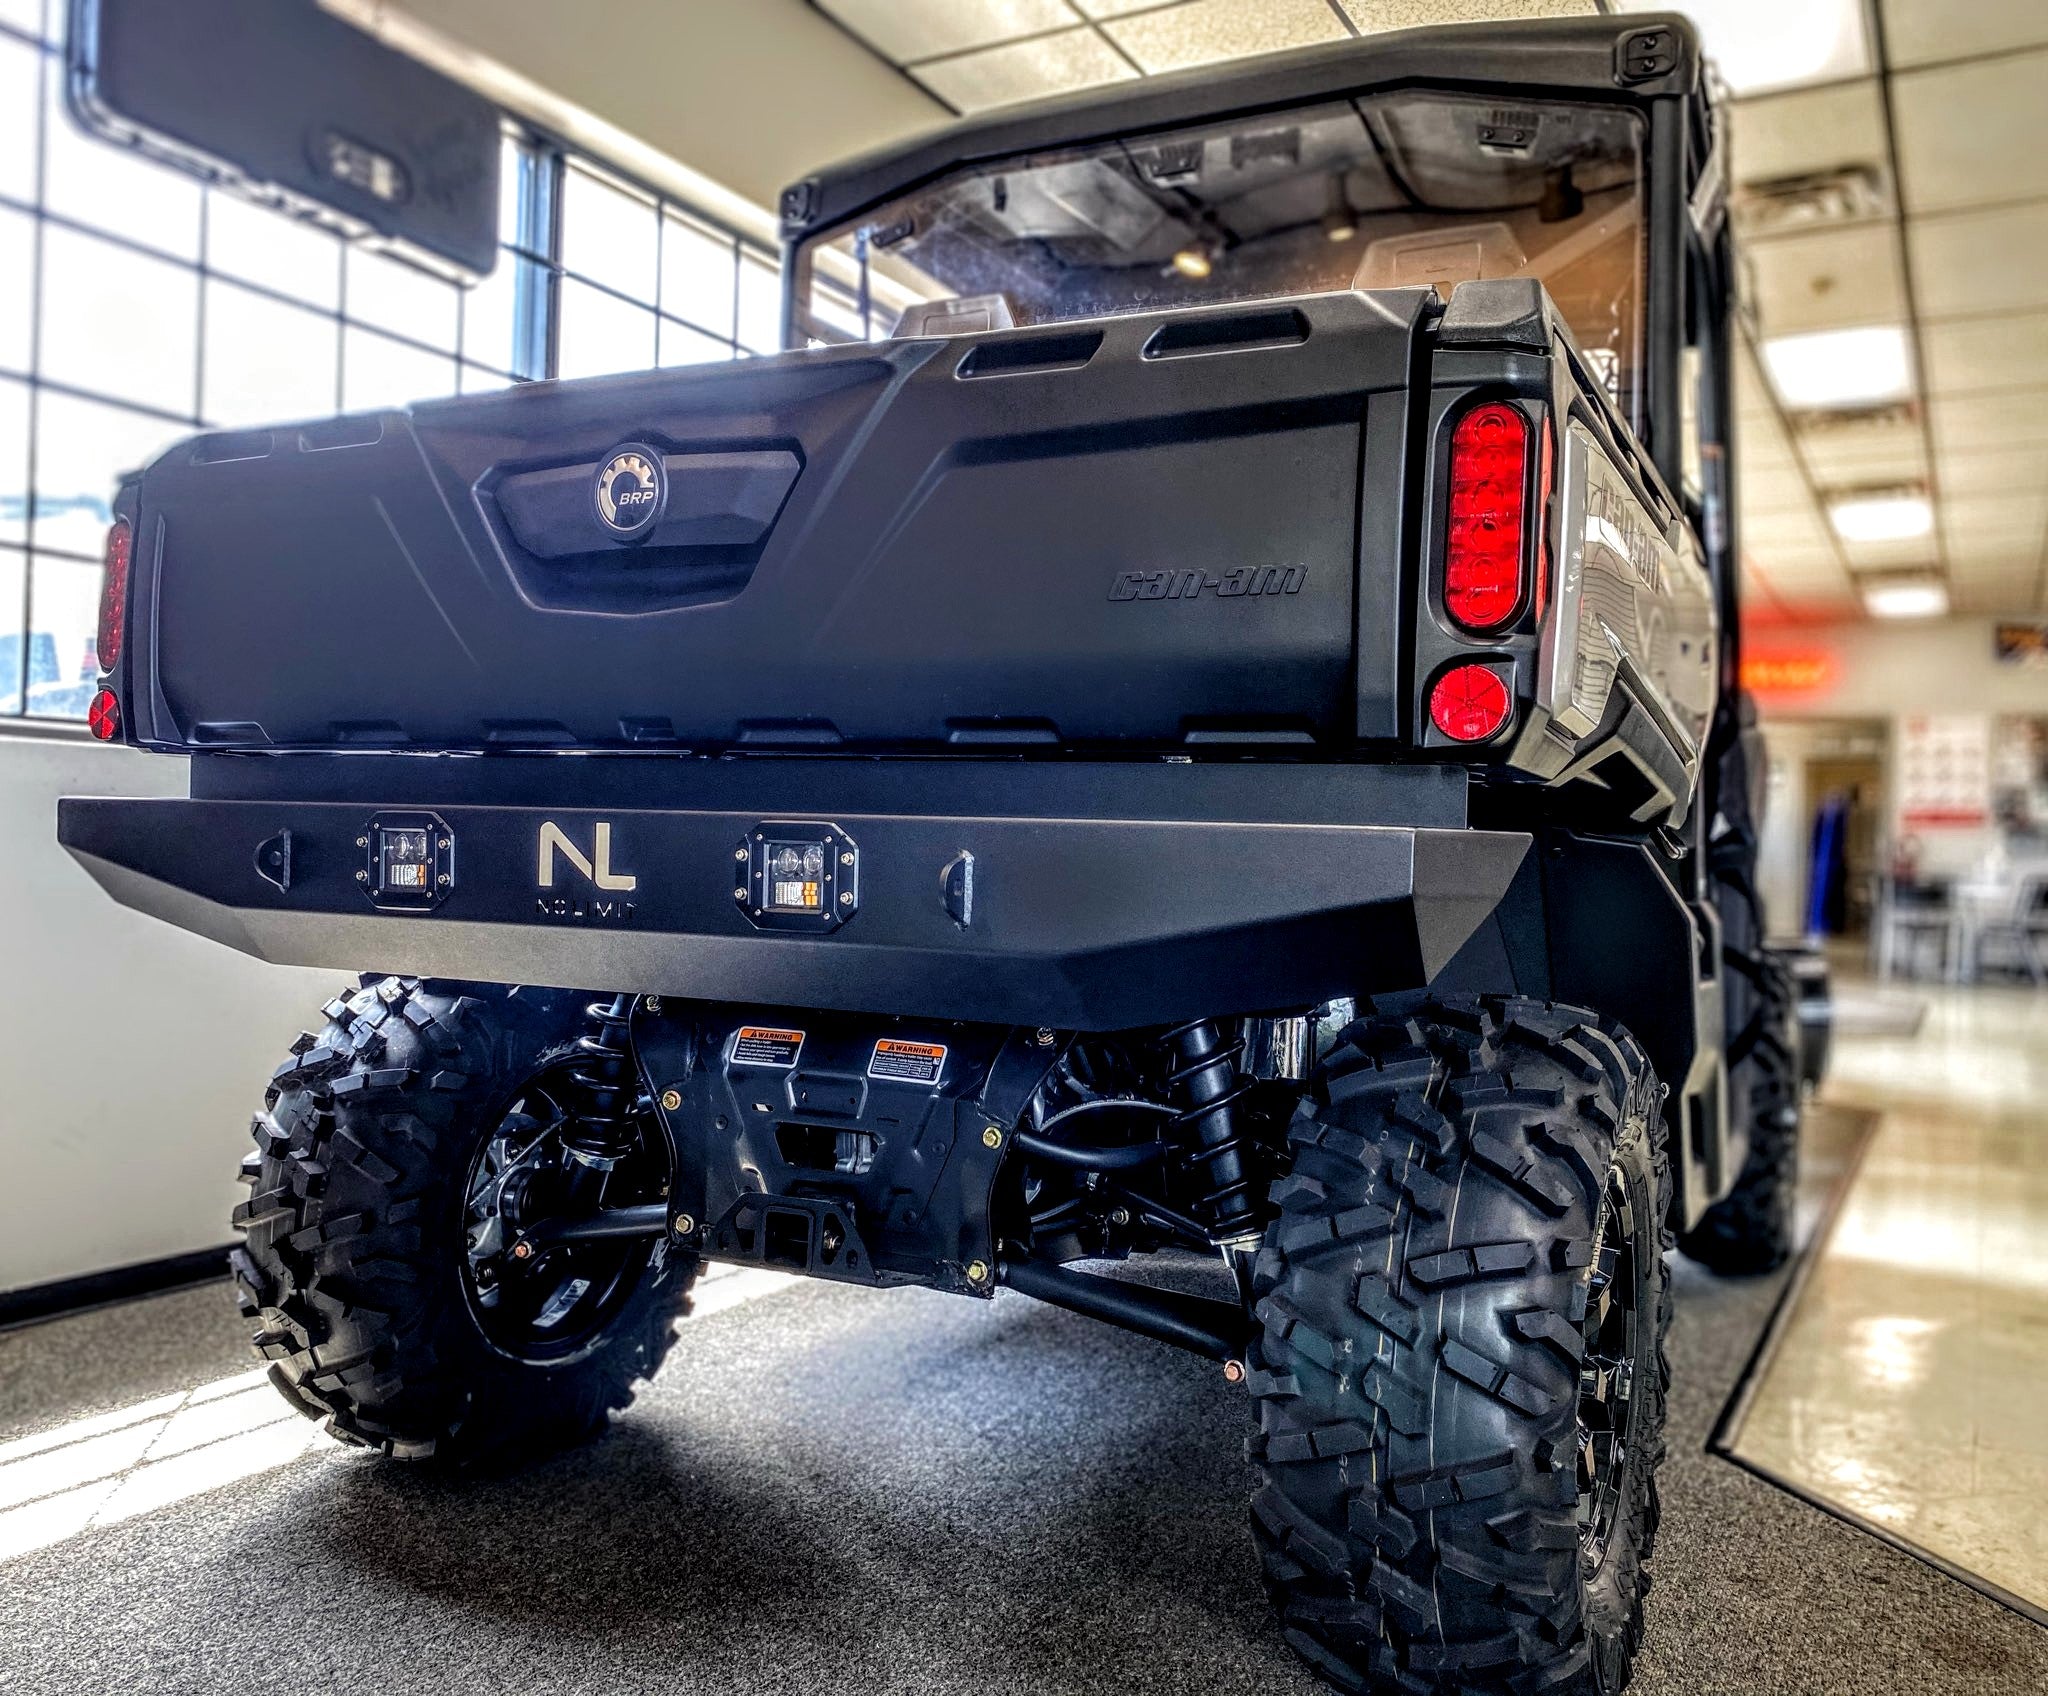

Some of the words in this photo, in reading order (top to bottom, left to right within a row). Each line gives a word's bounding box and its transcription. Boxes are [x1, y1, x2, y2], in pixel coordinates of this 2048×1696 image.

[619, 491, 654, 505] BRP
[1107, 562, 1308, 601] can-am
[538, 821, 636, 891] NL
[757, 1031, 794, 1041] WARNING
[896, 1045, 933, 1055] WARNING
